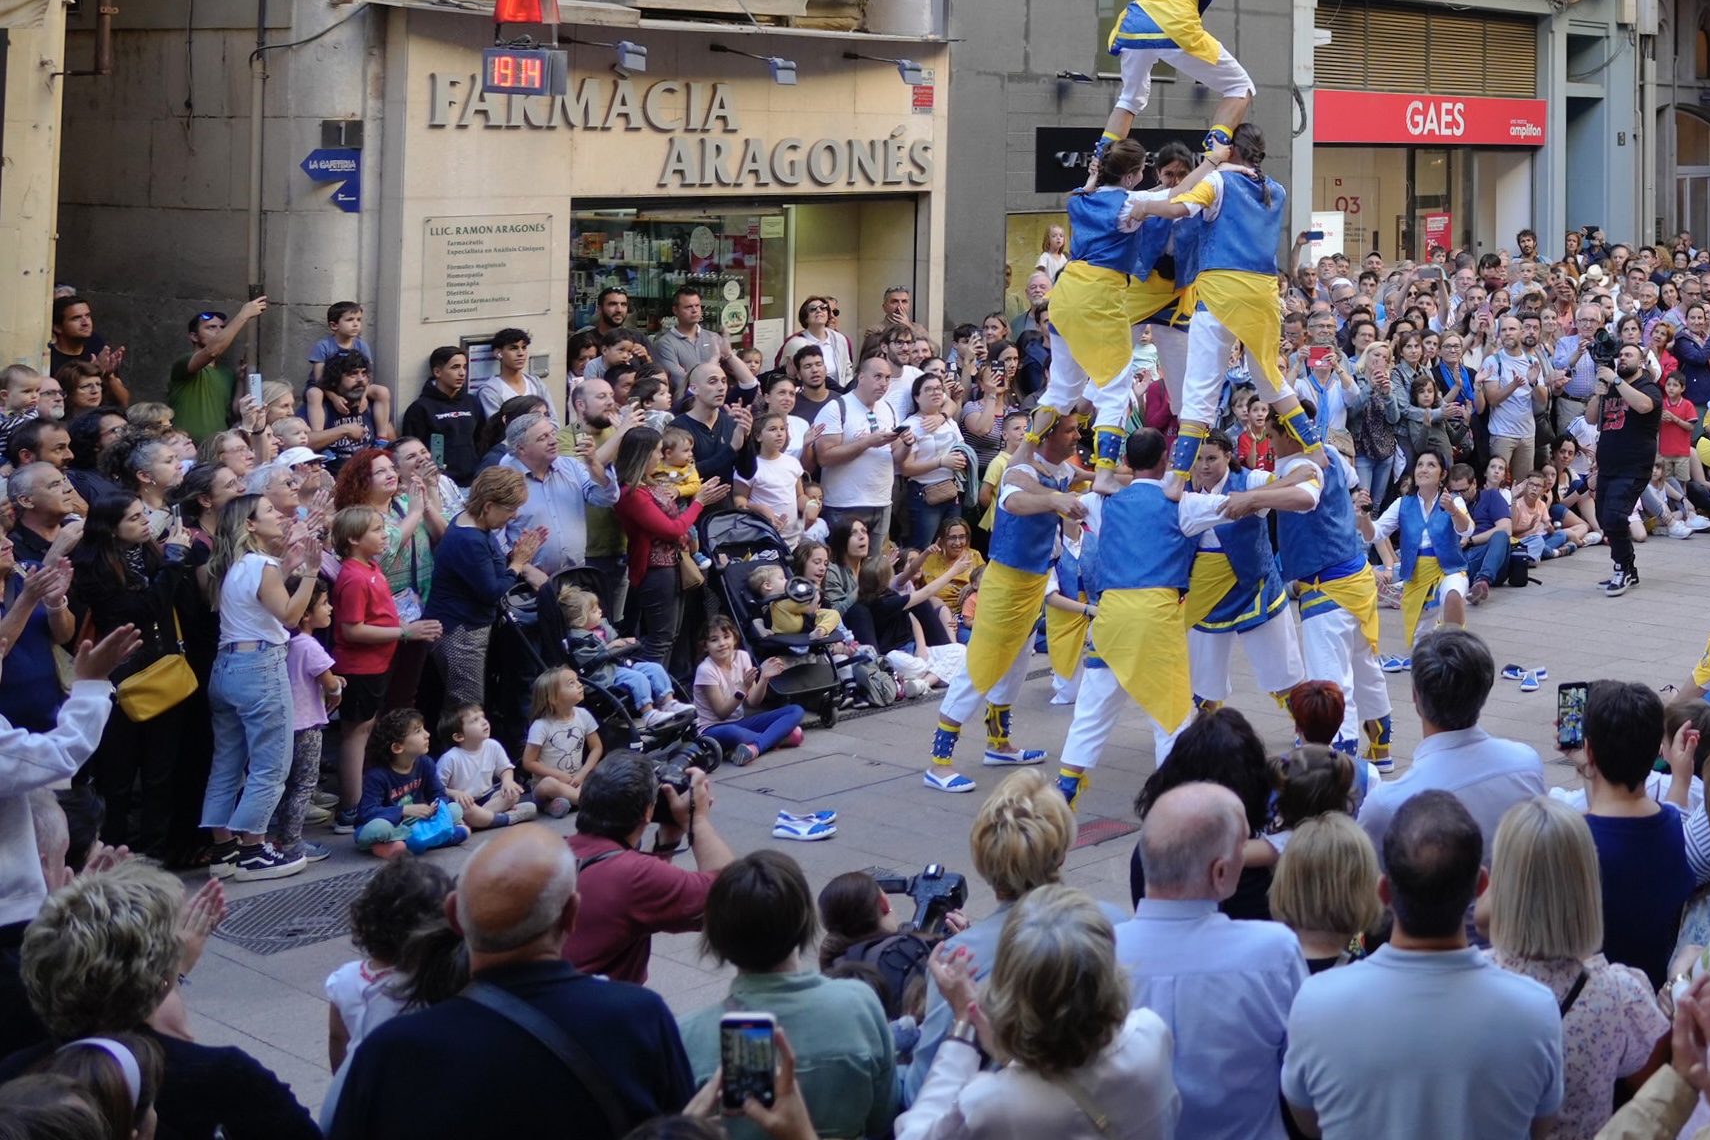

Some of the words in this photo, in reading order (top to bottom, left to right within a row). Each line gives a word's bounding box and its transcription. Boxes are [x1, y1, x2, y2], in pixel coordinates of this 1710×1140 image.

[428, 63, 740, 133] FARMÀCIA
[1406, 100, 1464, 136] GAES
[339, 122, 346, 146] 1
[1510, 124, 1541, 139] amplifon
[309, 160, 318, 169] LA
[657, 125, 935, 188] ARAGONÉS
[1335, 195, 1361, 214] 03
[430, 226, 454, 236] LLIC.
[455, 225, 493, 235] RAMON
[495, 223, 546, 234] ARAGONÉS
[446, 306, 477, 314] Laboratori
[1602, 410, 1626, 430] 23
